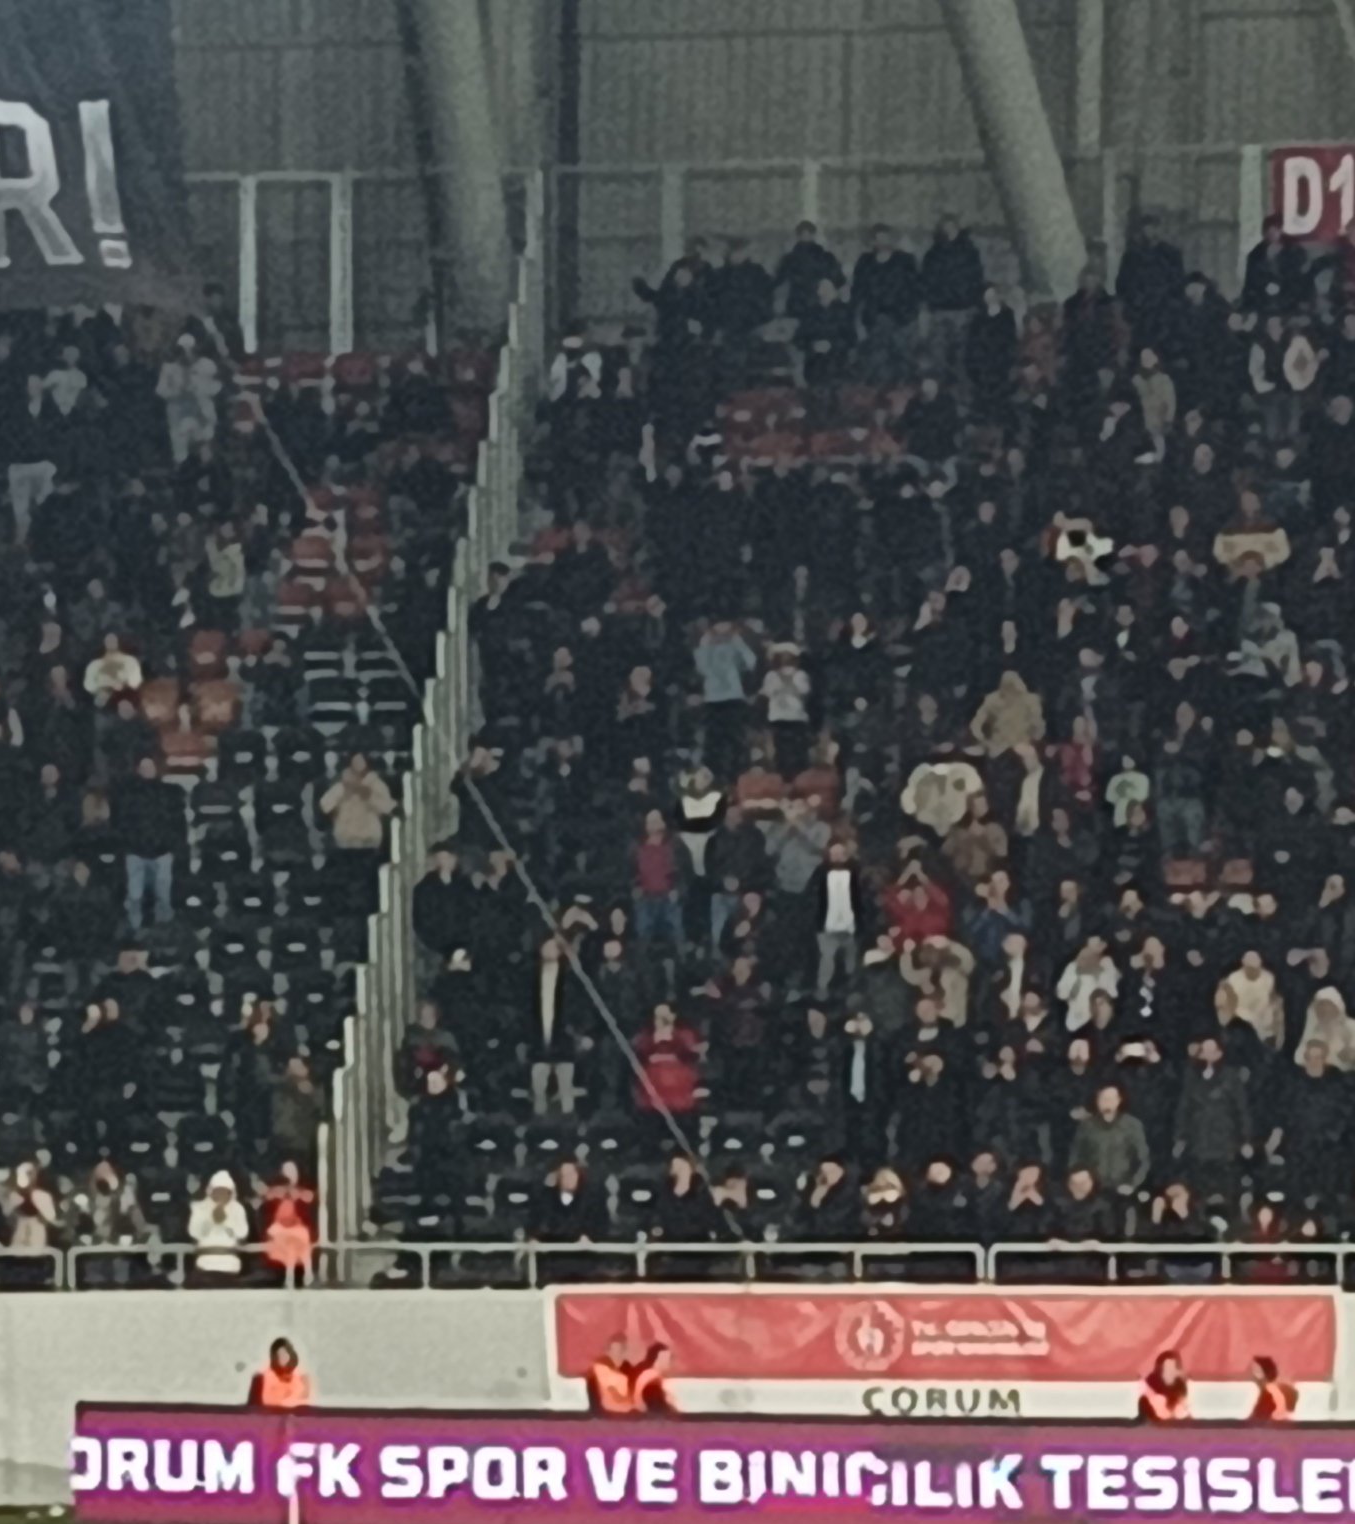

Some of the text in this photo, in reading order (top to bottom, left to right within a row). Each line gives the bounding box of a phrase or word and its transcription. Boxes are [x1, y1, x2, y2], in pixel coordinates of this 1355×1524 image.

[1283, 153, 1354, 236] D1
[277, 1442, 361, 1498] FK
[379, 1445, 568, 1501] SPOR
[585, 1446, 678, 1503] VE
